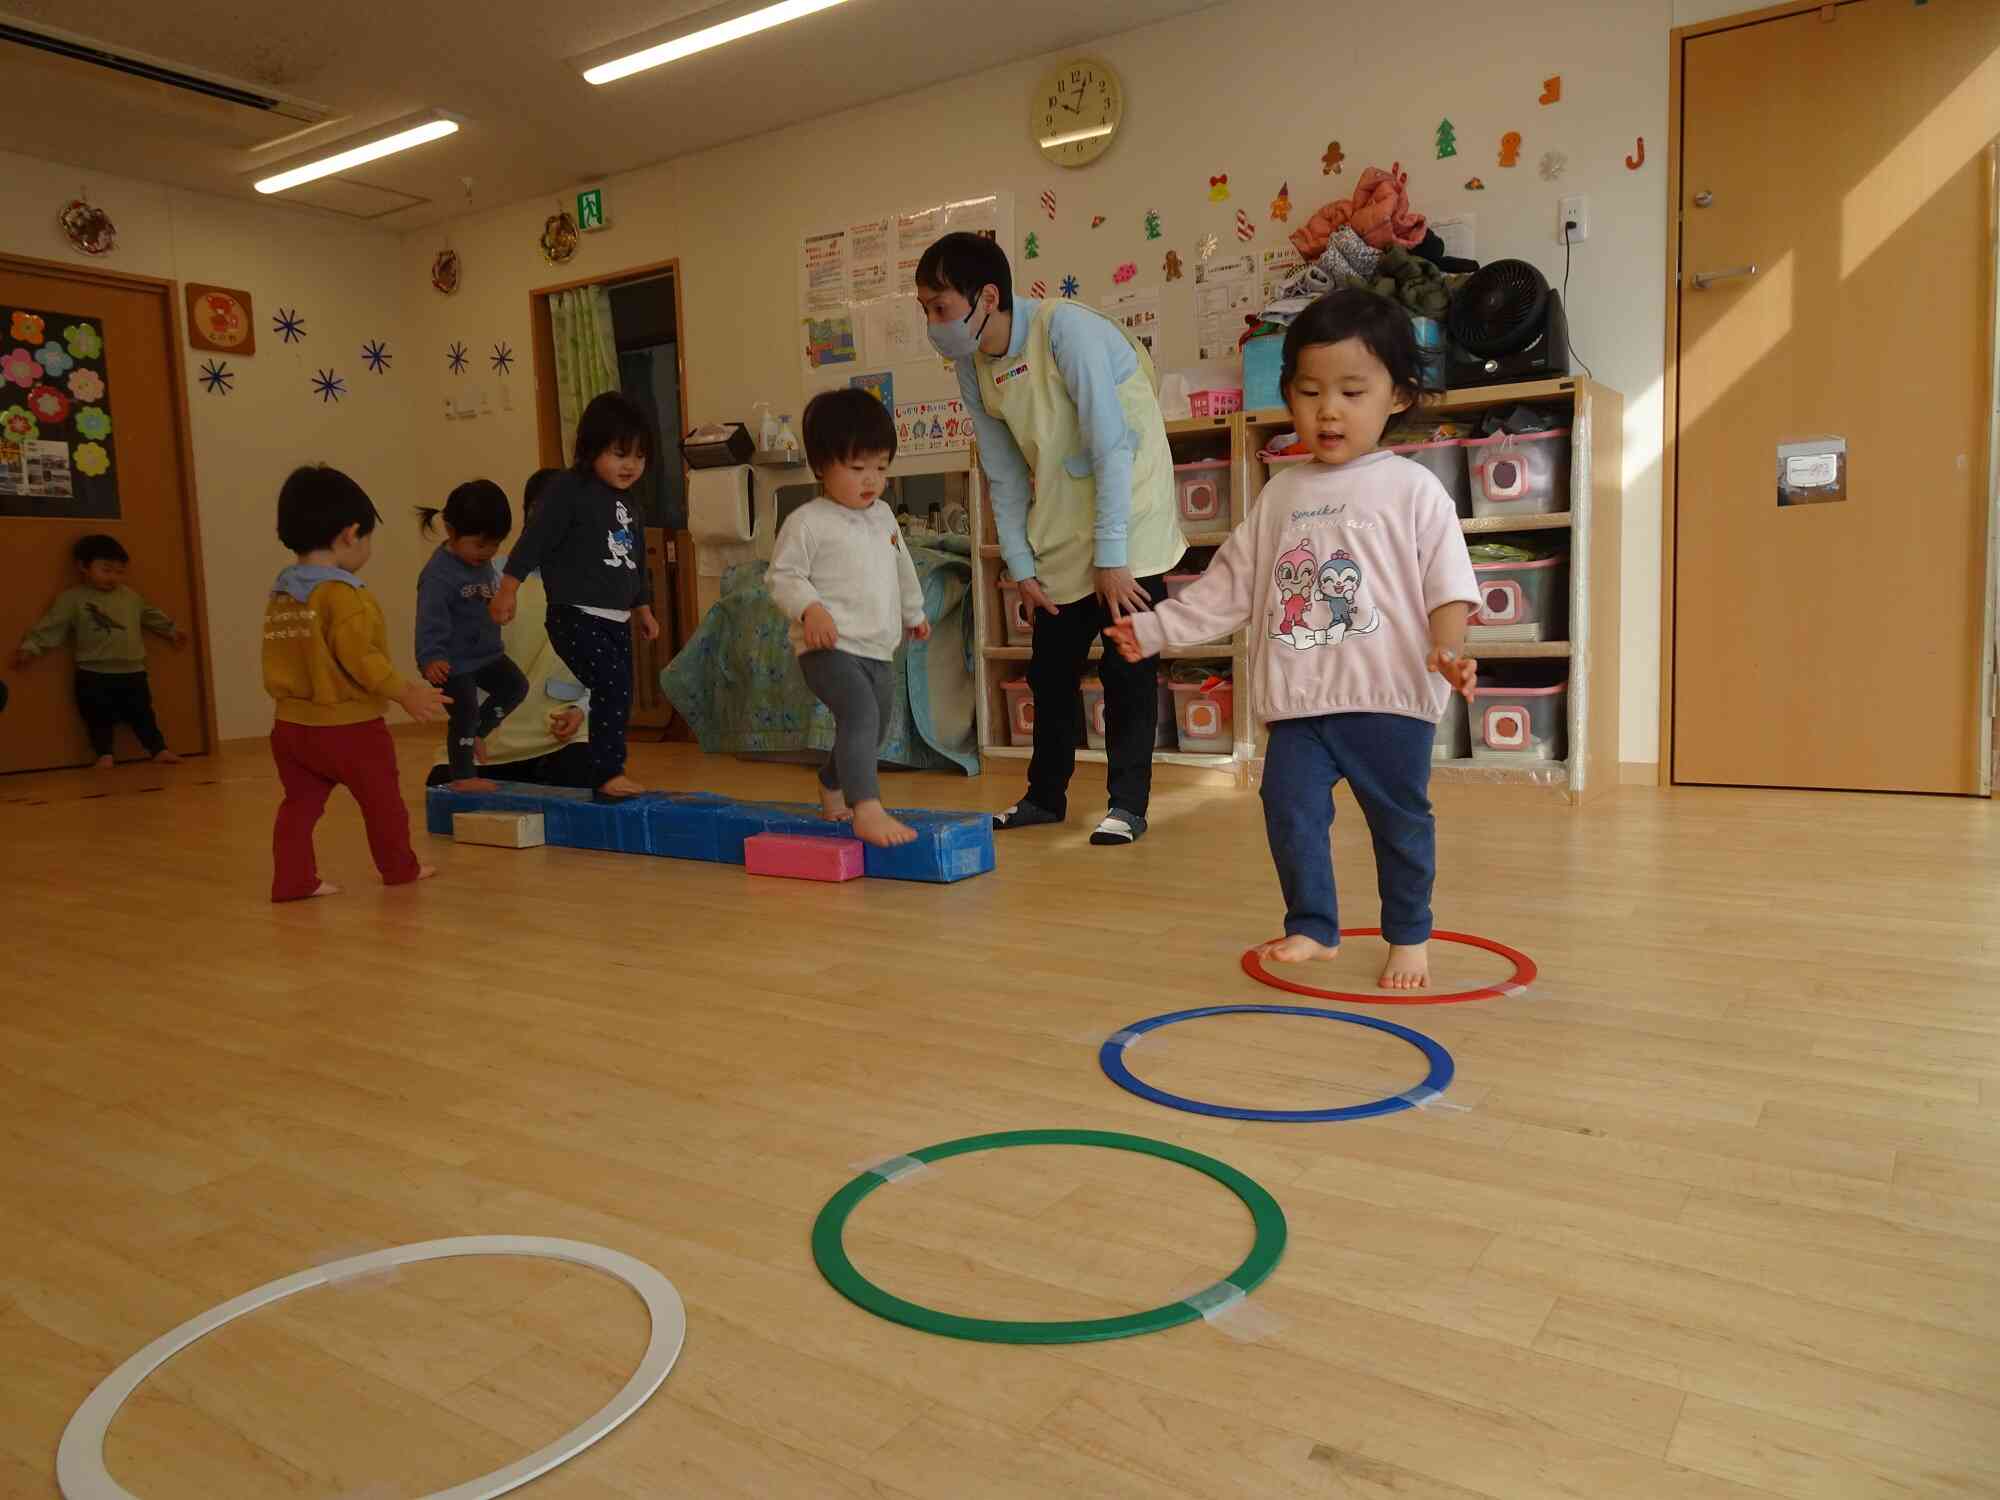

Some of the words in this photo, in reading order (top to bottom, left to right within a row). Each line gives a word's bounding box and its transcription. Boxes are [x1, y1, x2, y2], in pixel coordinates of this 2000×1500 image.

[1071, 70, 1080, 84] 12
[1057, 79, 1065, 93] 11
[1098, 79, 1106, 93] 2
[1104, 96, 1111, 110] 3
[1046, 114, 1053, 127] 9
